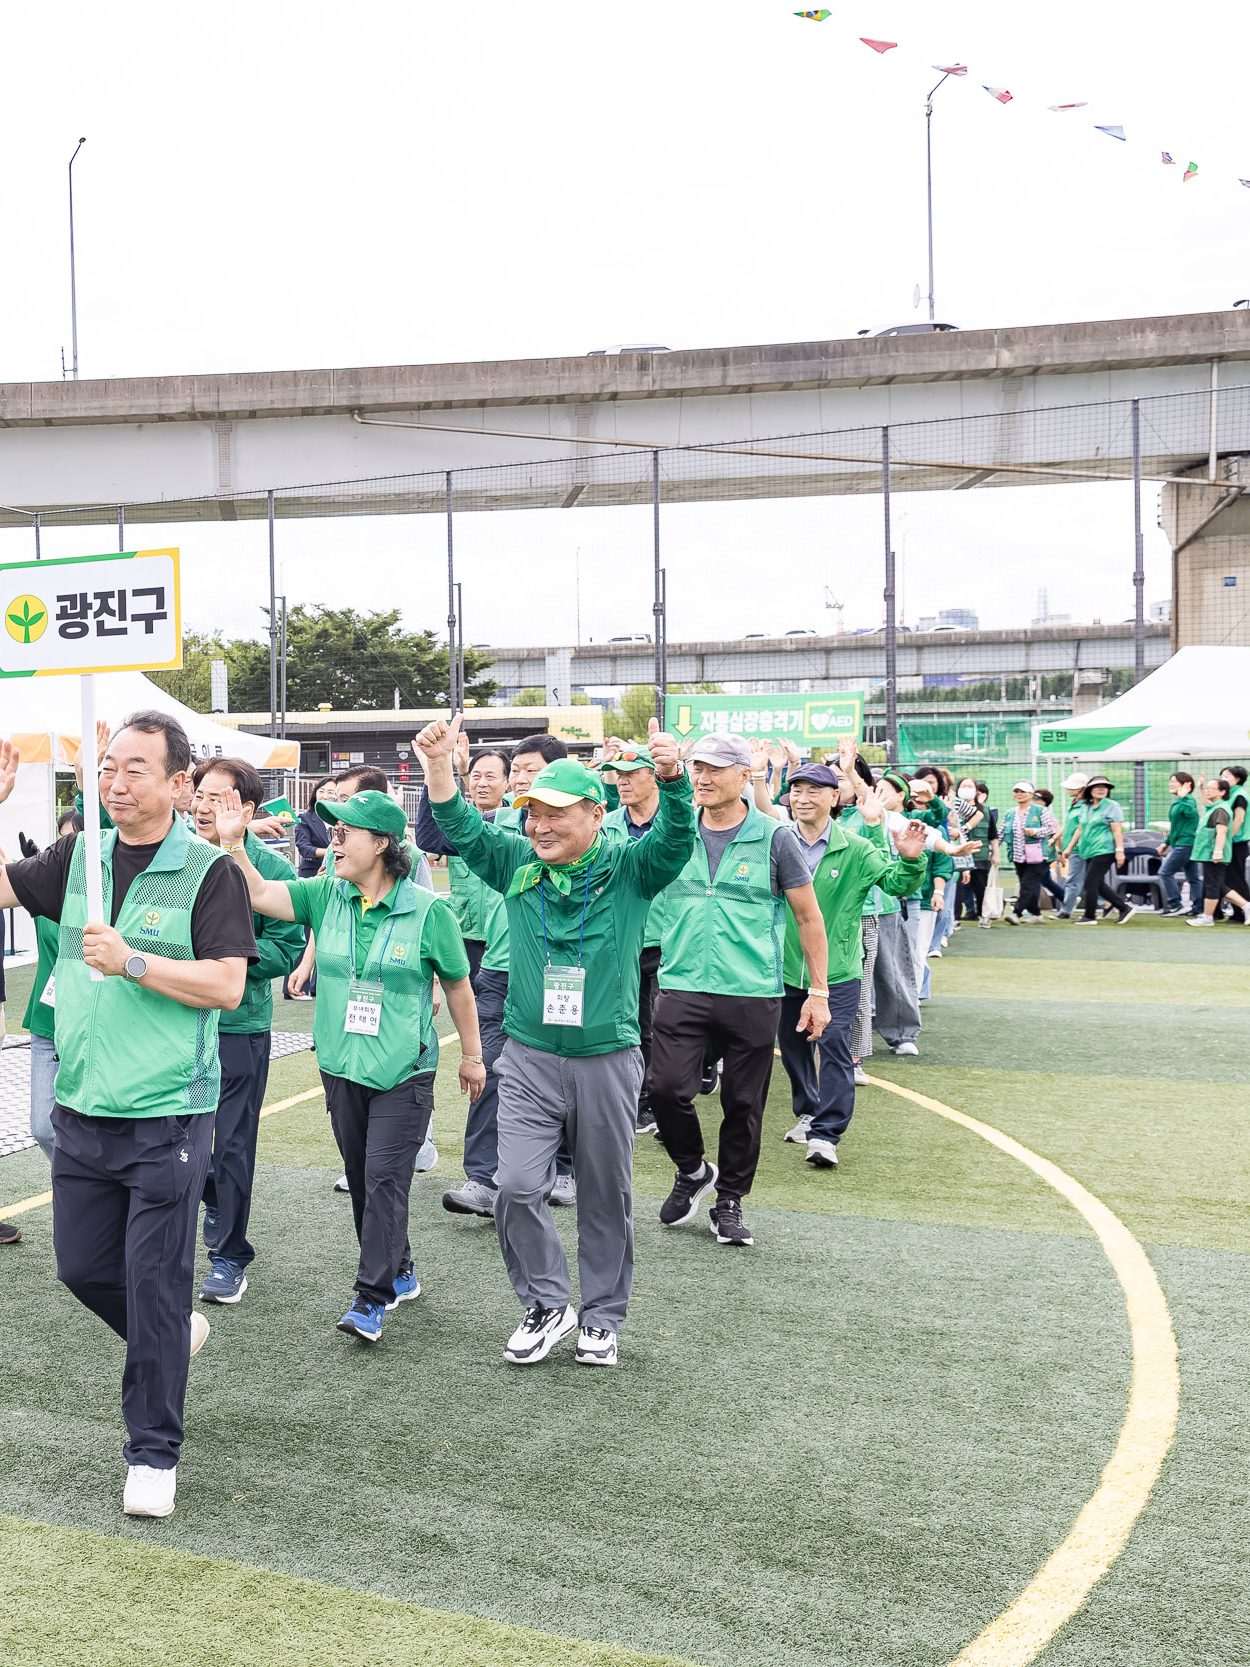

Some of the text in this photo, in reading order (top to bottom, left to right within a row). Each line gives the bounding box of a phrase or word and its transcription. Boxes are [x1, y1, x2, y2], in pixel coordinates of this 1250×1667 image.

[56, 587, 167, 639] 광진구
[700, 710, 804, 732] 자동심장충격기
[828, 715, 854, 727] AED
[1042, 731, 1068, 742] 근면
[139, 926, 160, 937] SMU
[390, 957, 406, 966] SMU
[553, 982, 574, 990] 광진구
[356, 995, 375, 1003] 광진구
